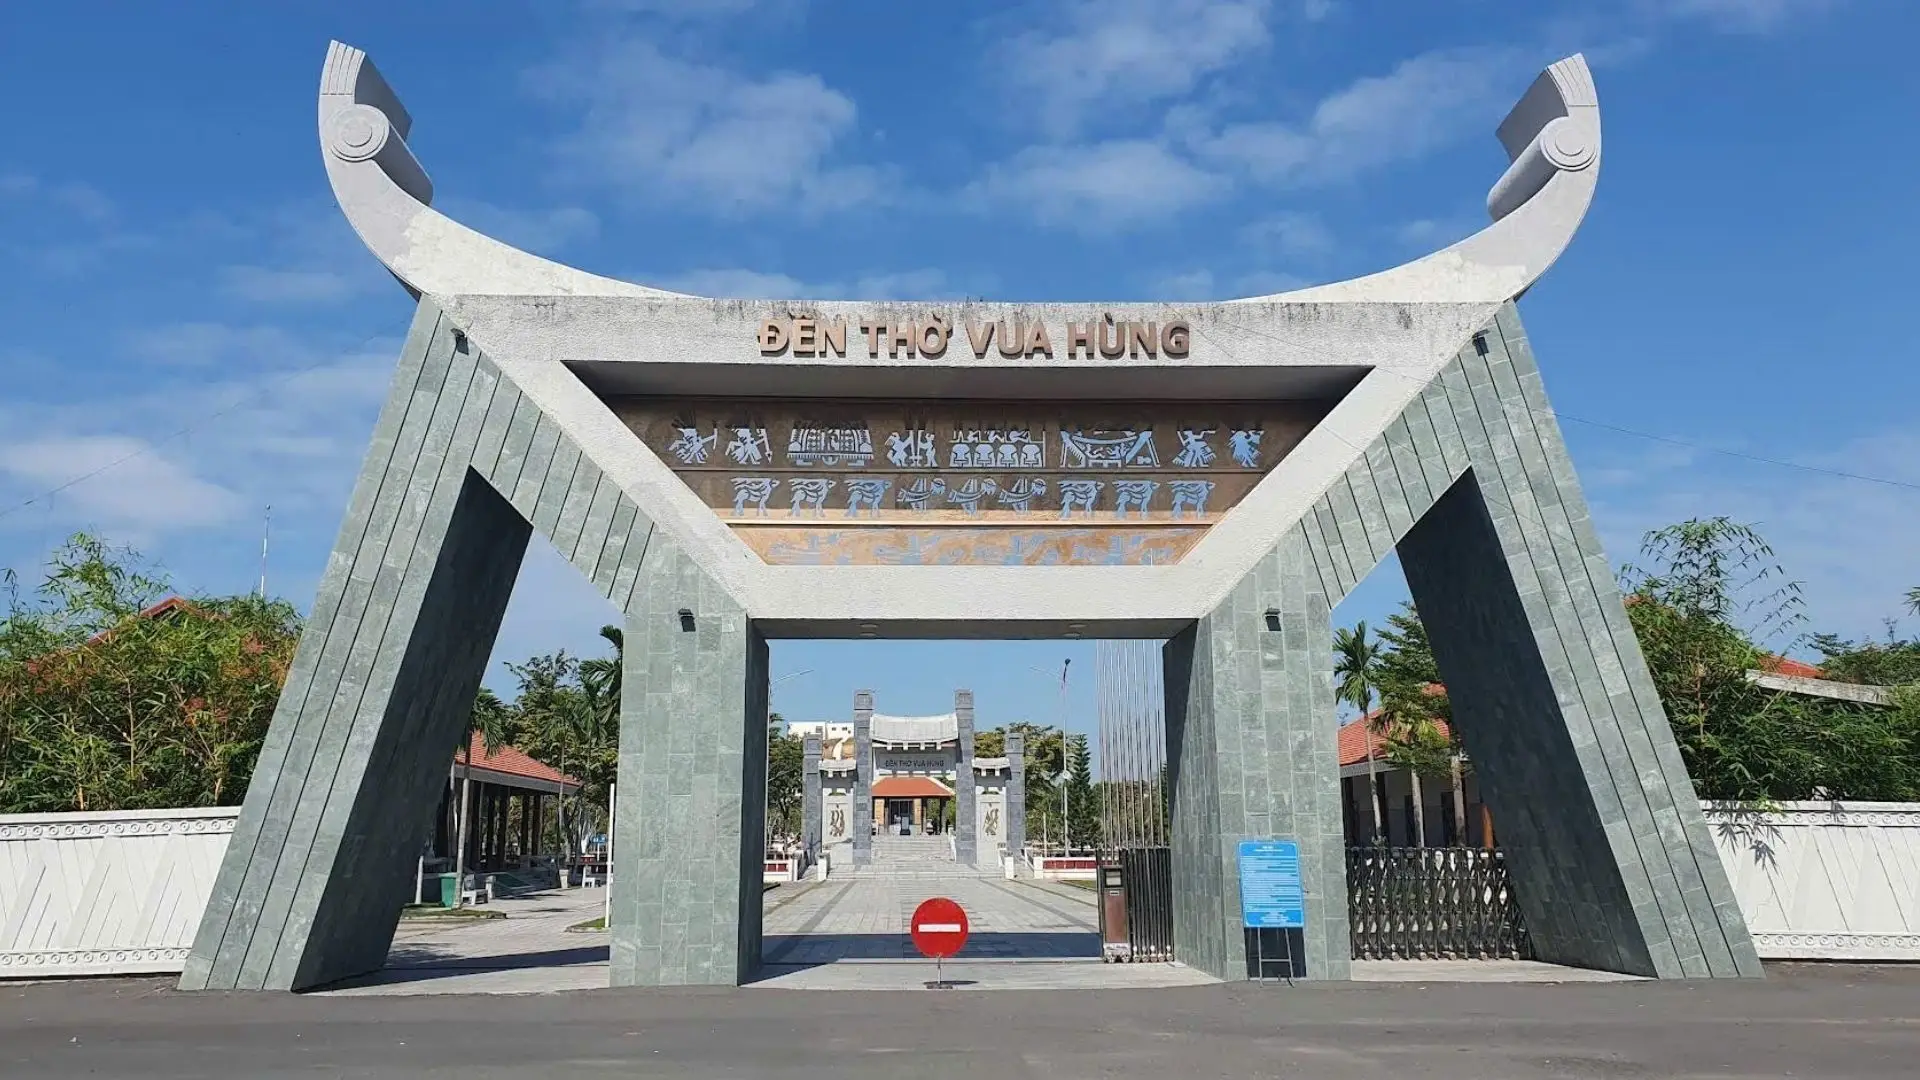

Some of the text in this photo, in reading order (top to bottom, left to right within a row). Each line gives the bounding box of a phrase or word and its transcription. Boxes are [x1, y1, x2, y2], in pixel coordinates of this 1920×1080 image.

[860, 313, 953, 359] THỜ
[964, 320, 1053, 359] VUA
[1067, 312, 1189, 359] HÙNG
